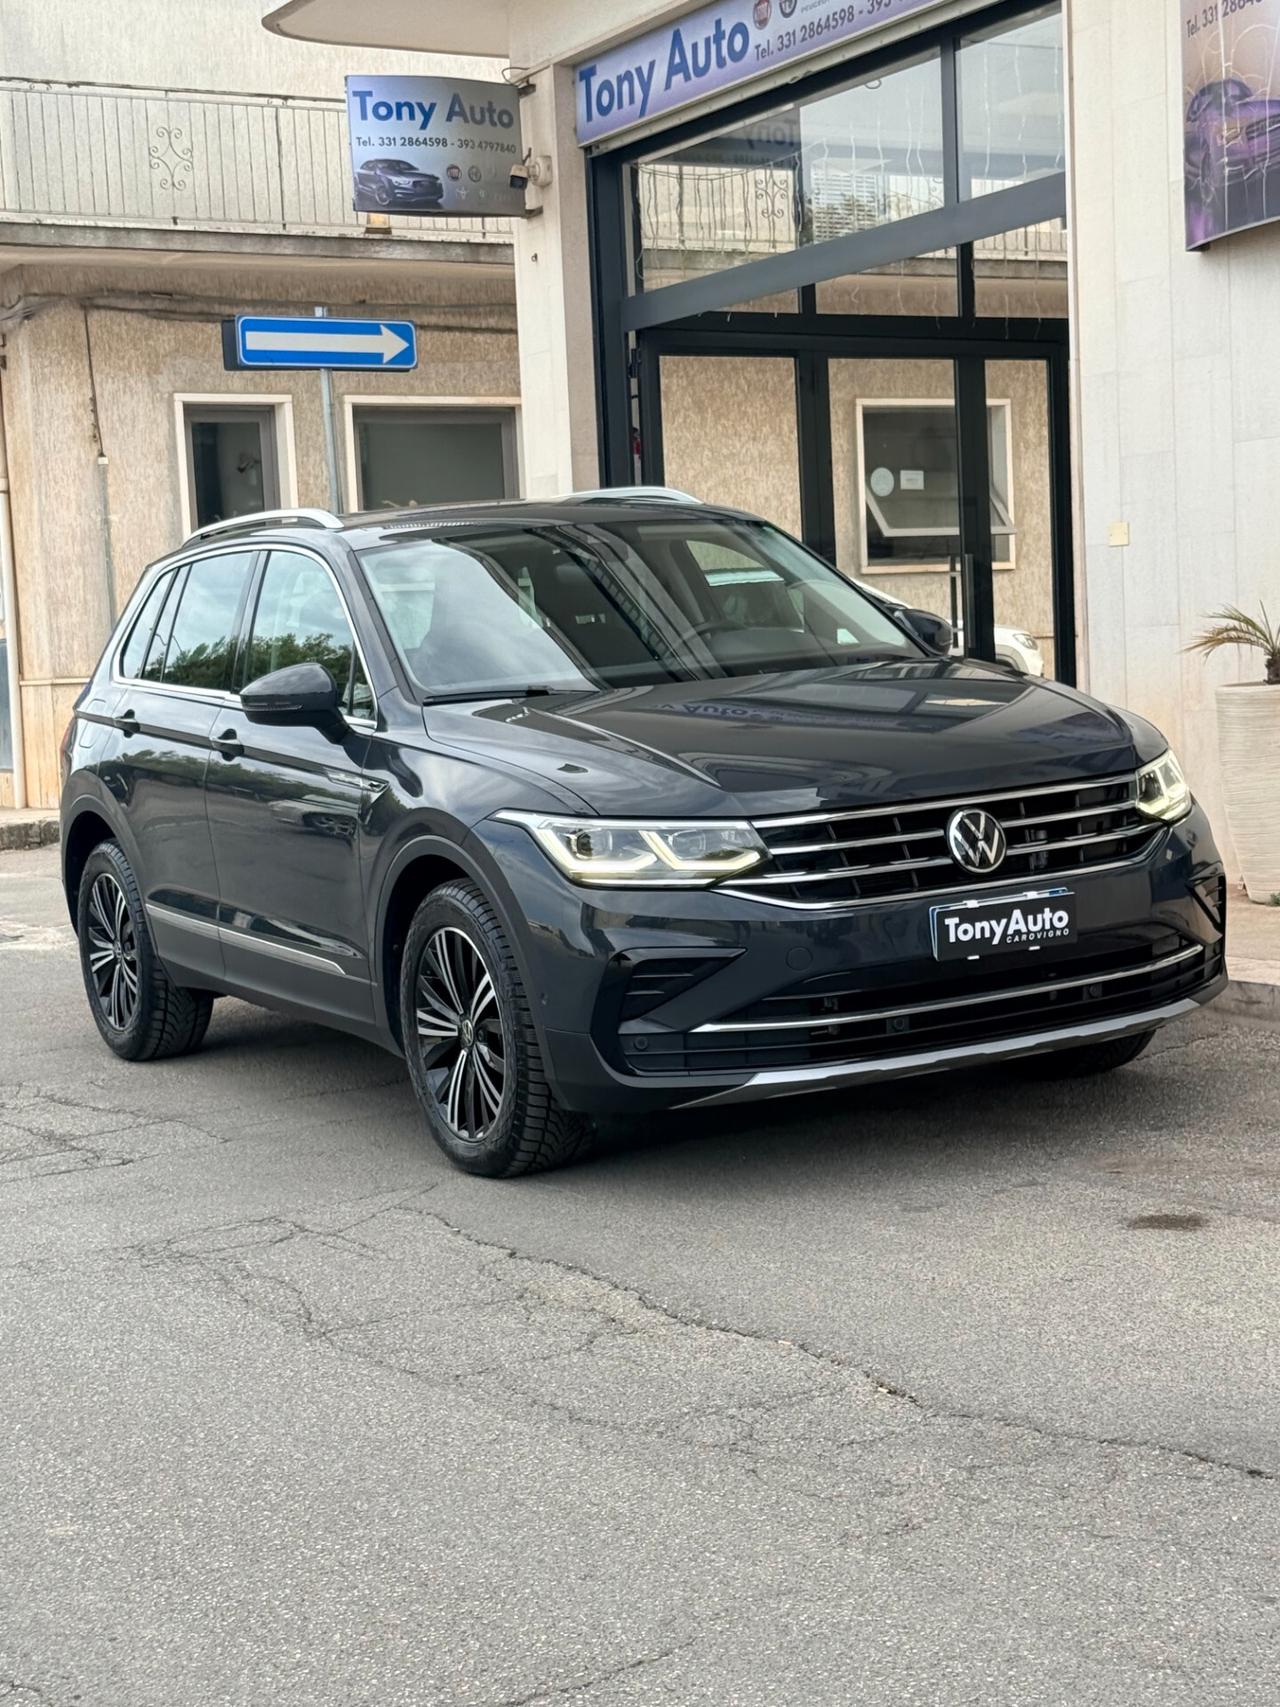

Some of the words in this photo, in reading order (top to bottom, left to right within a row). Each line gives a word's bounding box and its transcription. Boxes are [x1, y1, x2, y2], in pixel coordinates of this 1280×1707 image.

[755, 39, 774, 61] Tel.
[777, 29, 796, 52] 331
[800, 5, 855, 43] 2864598
[1186, 15, 1200, 38] Tel.
[1202, 3, 1218, 27] 331
[579, 60, 655, 123] Tony
[664, 17, 750, 90] Auto
[352, 91, 436, 130] Tony
[445, 93, 514, 129] Auto
[356, 136, 375, 148] Tel.
[378, 136, 397, 147] 331
[400, 136, 448, 148] 2864598
[457, 138, 476, 150] 393
[1006, 928, 1070, 943] CAROVIGNO
